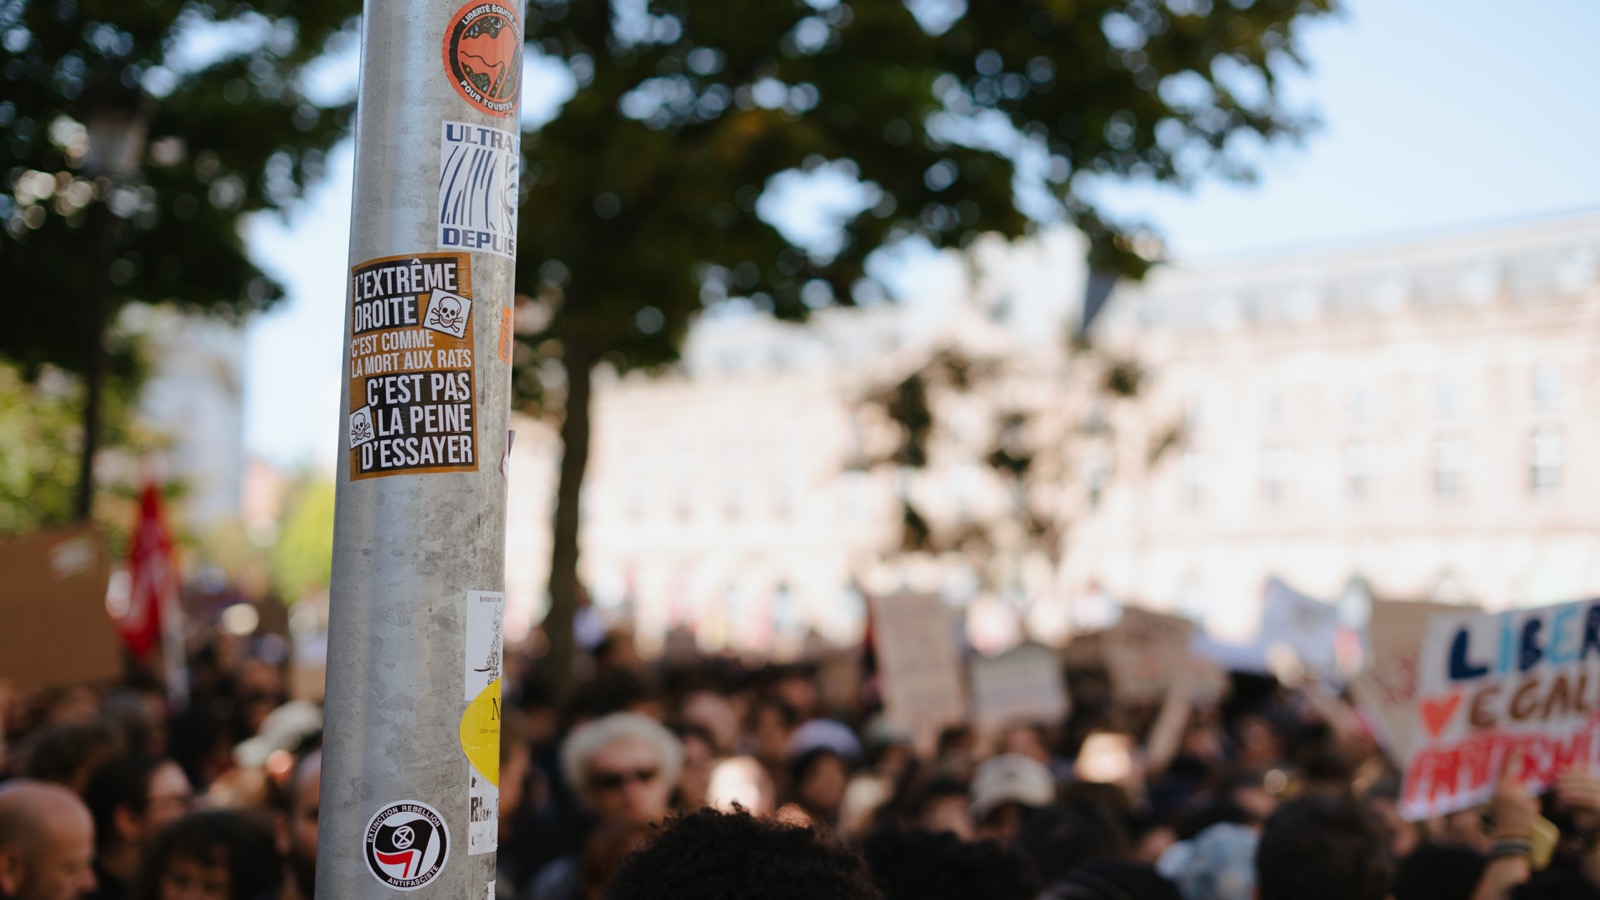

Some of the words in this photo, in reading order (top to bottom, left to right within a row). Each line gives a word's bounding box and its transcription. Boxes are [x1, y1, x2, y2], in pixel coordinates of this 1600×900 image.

[462, 5, 491, 25] LIBERTÉ
[460, 80, 482, 103] POUR
[442, 227, 514, 256] DEPUIS
[354, 258, 458, 303] L'EXTRÊME
[354, 296, 417, 333] DROITE
[351, 334, 378, 358] C'EST
[382, 329, 434, 352] COMME
[352, 359, 363, 379] LA
[365, 352, 400, 375] MORT
[404, 349, 434, 371] AUX
[437, 348, 472, 371] RATS
[367, 374, 424, 407] C'EST
[430, 372, 471, 402] PAS
[377, 407, 404, 437] LA
[410, 404, 472, 434] PEINE
[362, 435, 473, 471] D'ESSAYER
[367, 806, 399, 843] EXTINCTION
[401, 805, 442, 828] REBELLION
[387, 865, 439, 887] ANTIFASCISTE
